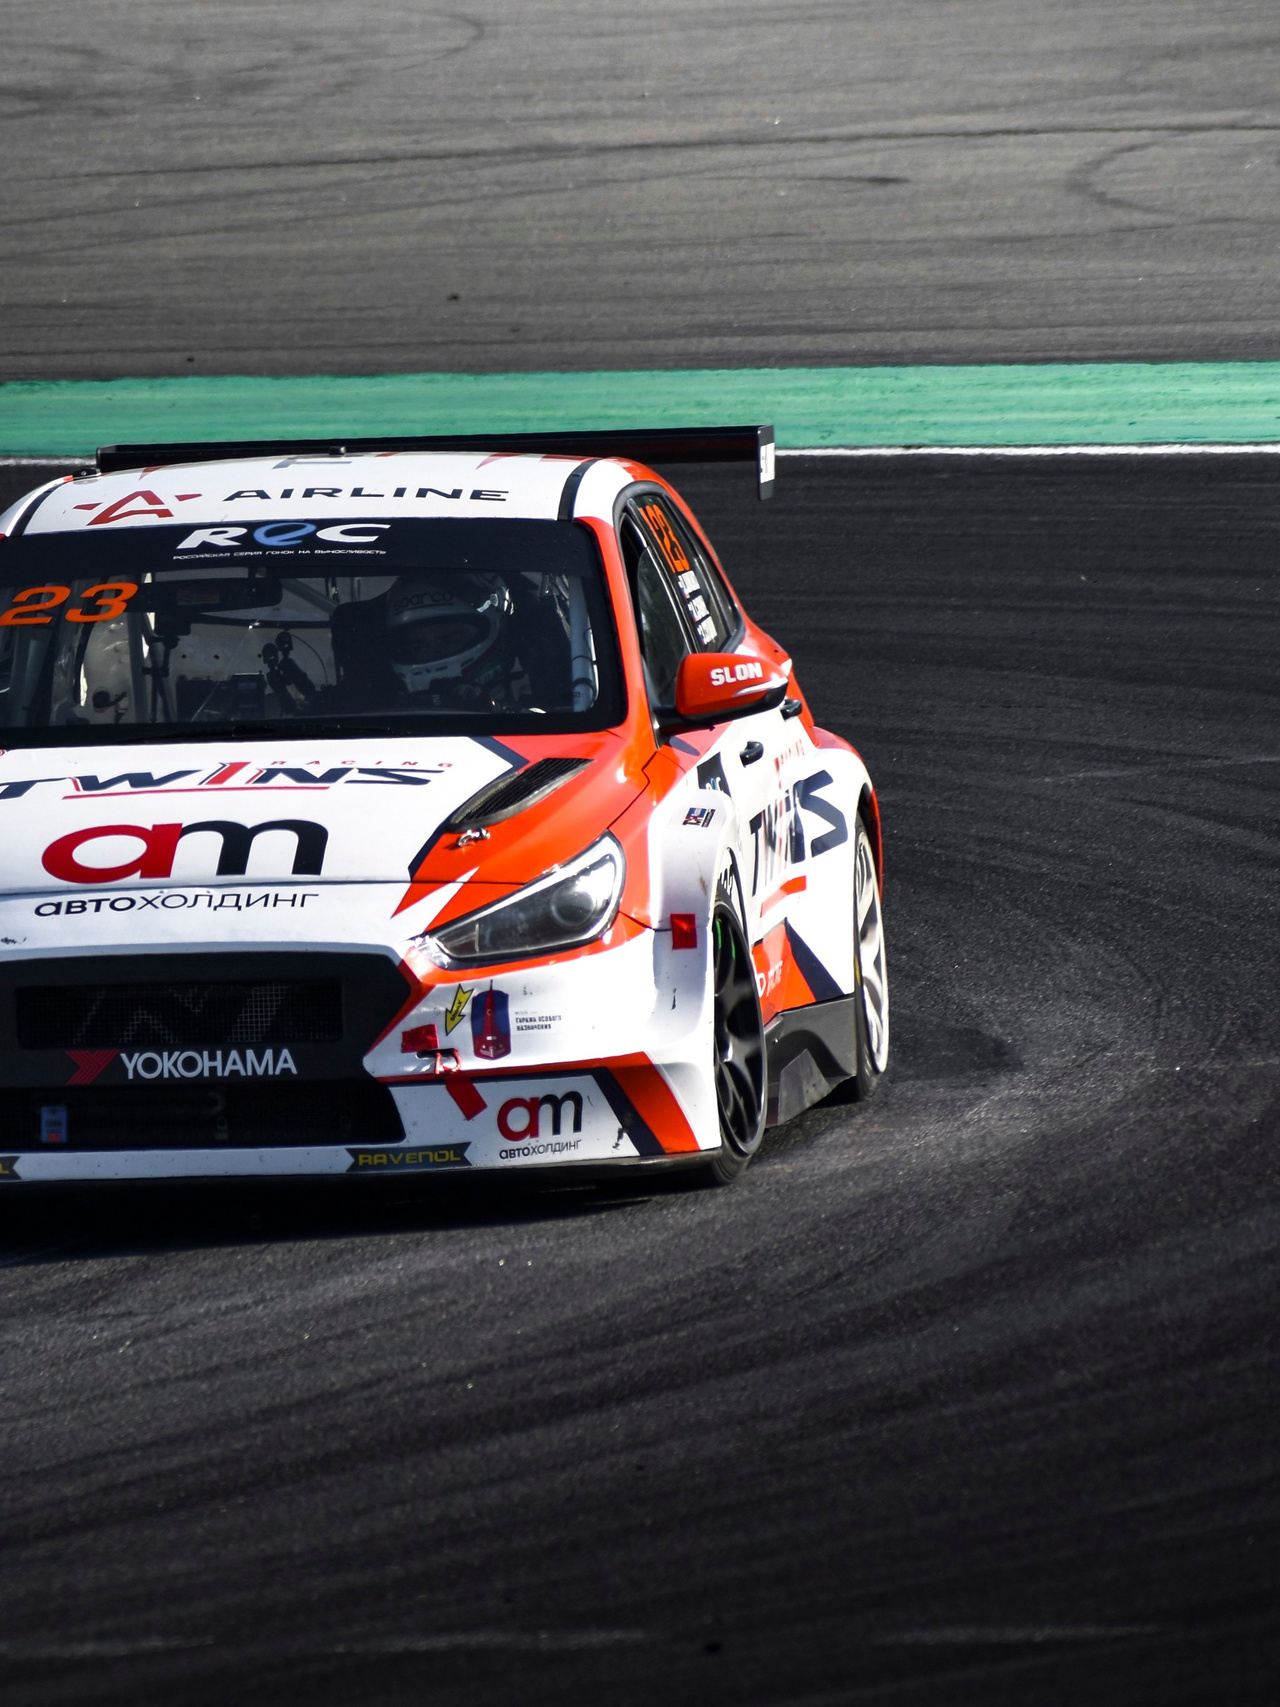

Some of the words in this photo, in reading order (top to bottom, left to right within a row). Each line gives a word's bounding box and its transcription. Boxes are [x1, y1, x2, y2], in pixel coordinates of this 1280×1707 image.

[221, 485, 510, 502] AIRLINE
[710, 662, 764, 687] SLON
[270, 760, 453, 768] RACING
[120, 1048, 298, 1080] YOKOHAMA
[358, 1148, 462, 1167] RAVENOL
